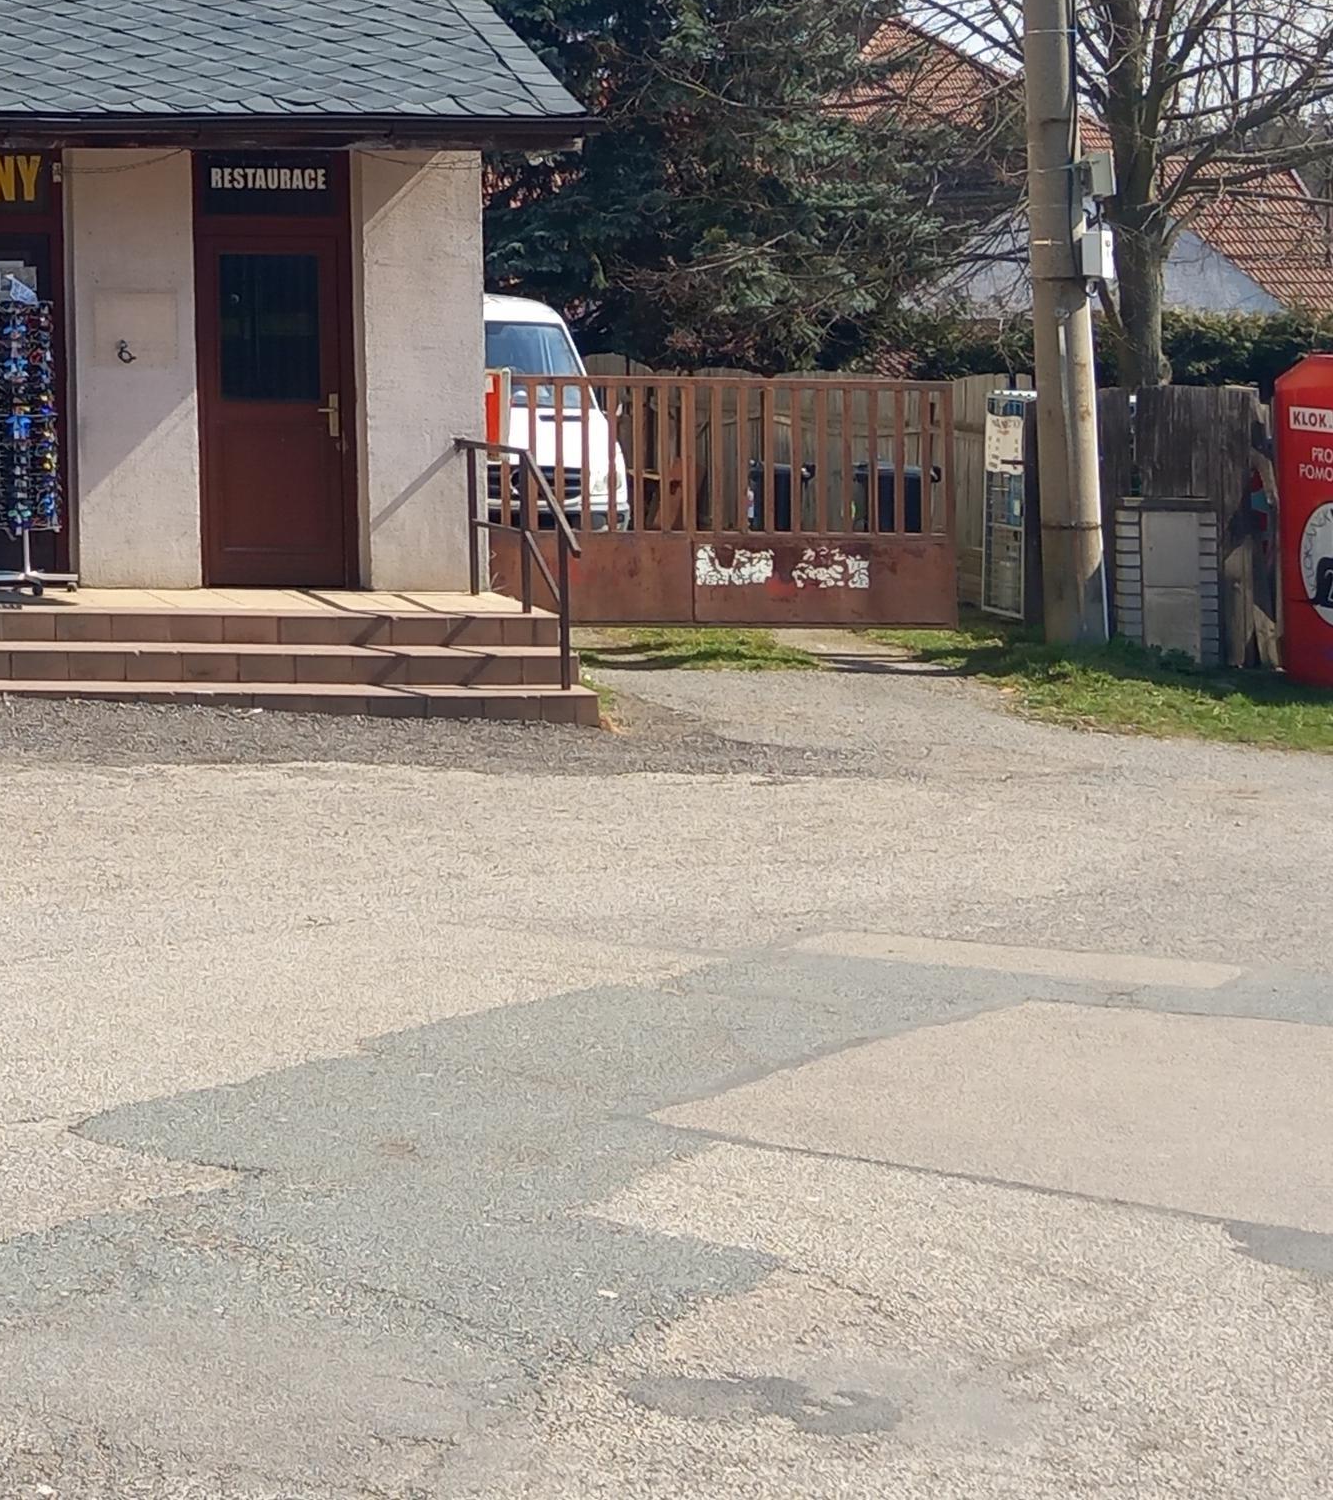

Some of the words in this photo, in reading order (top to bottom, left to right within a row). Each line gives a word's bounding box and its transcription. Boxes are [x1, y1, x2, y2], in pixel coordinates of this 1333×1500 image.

[210, 167, 326, 190] RESTAURACE
[1293, 410, 1333, 429] KLOK
[1311, 447, 1333, 464] PRO
